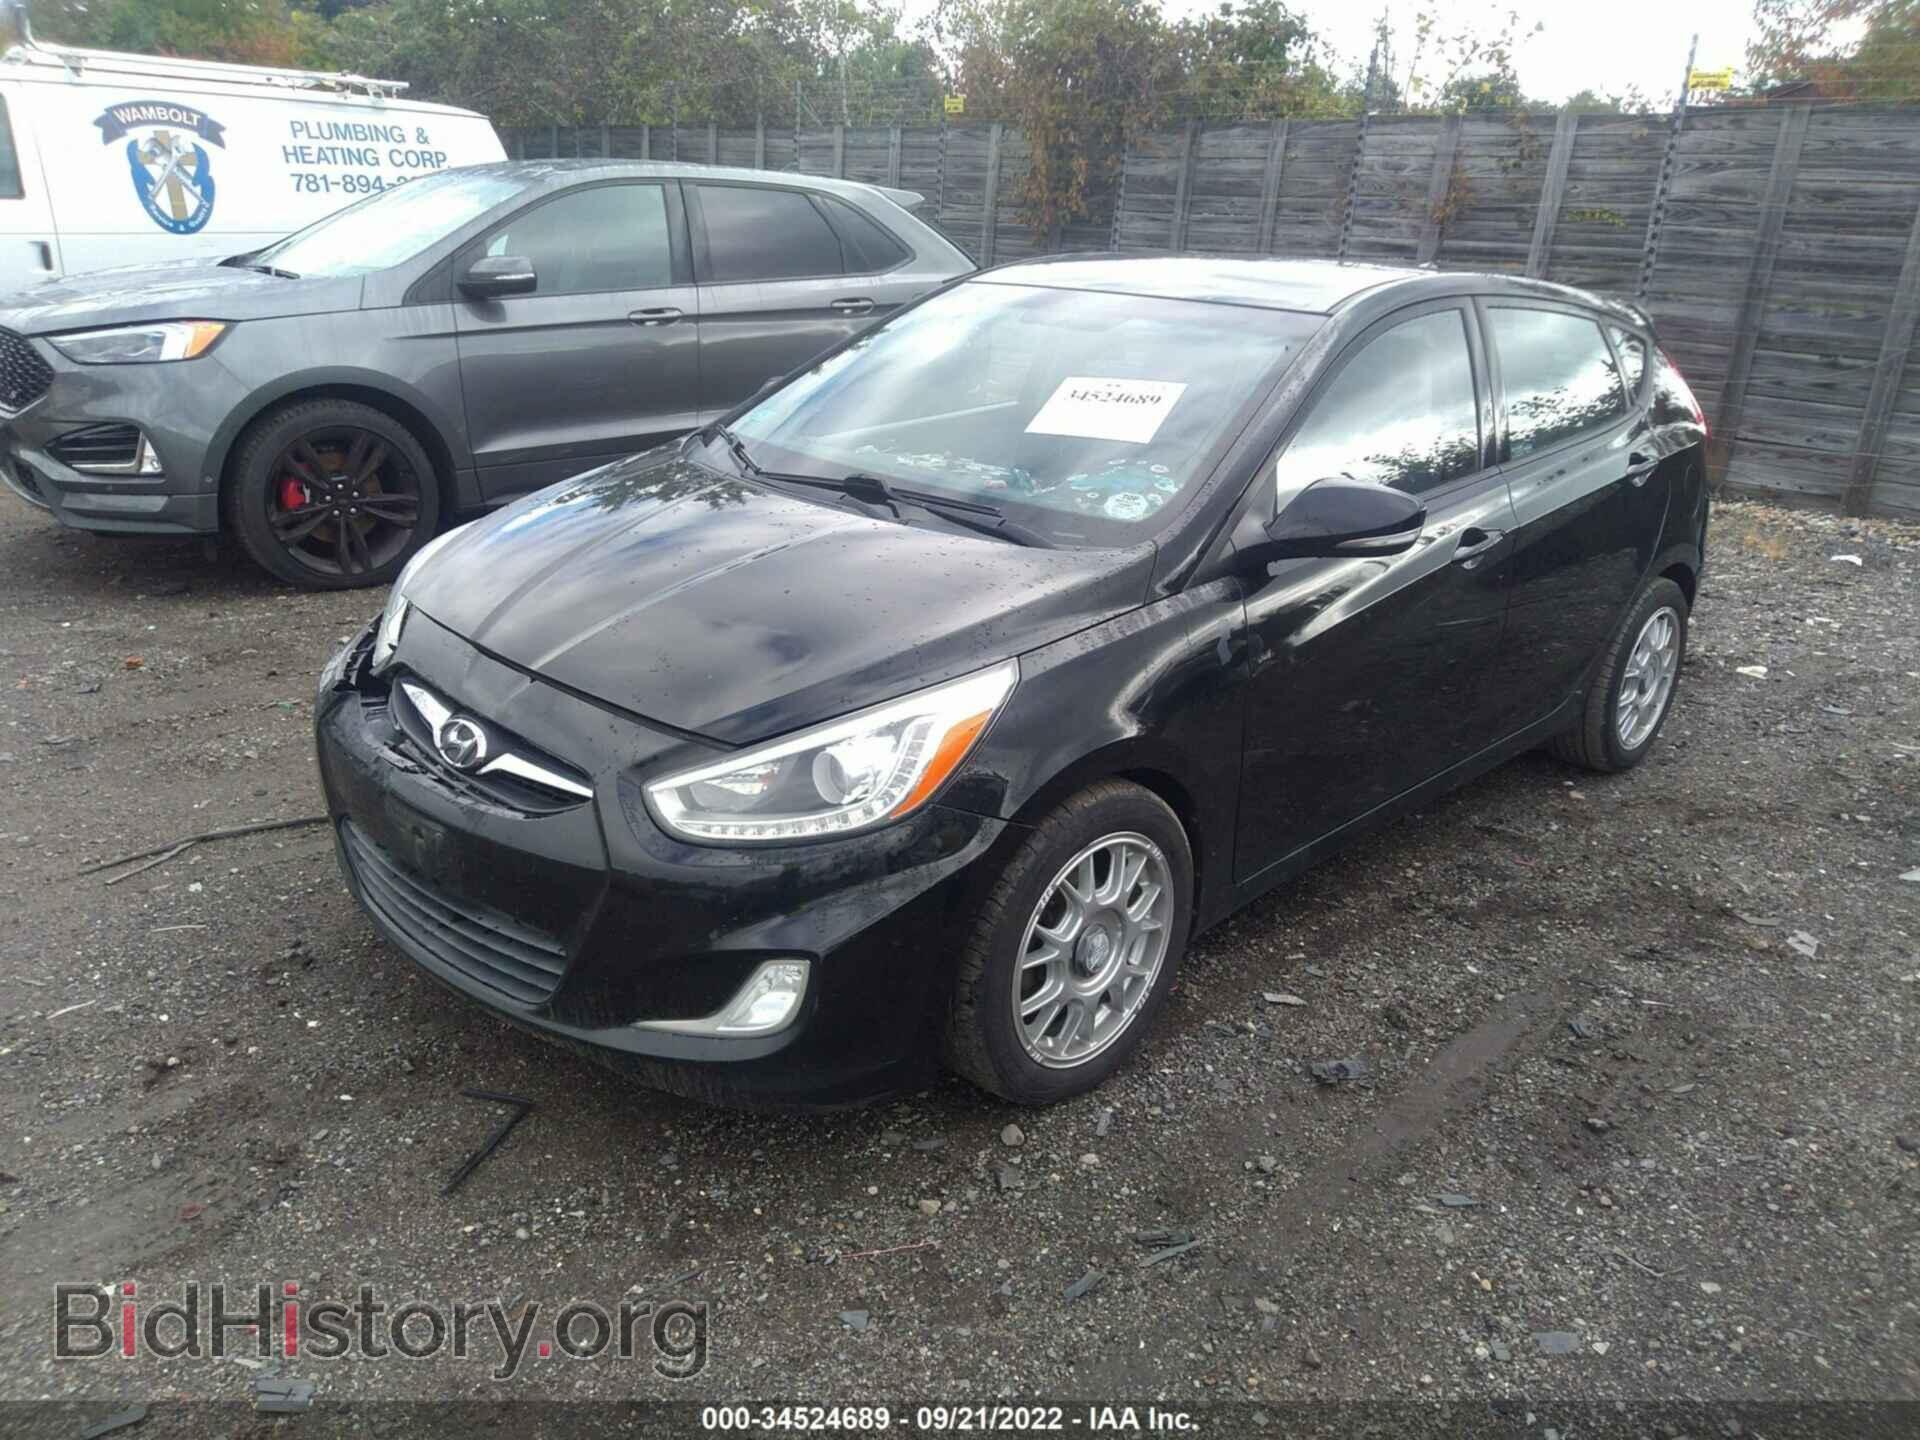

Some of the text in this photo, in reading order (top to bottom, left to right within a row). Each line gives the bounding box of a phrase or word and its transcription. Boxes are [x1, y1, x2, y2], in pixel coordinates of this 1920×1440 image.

[113, 106, 200, 125] WAMBOLT
[289, 120, 430, 144] PLUMBING &
[281, 145, 380, 167] HEATING
[289, 173, 418, 193] 781-894-
